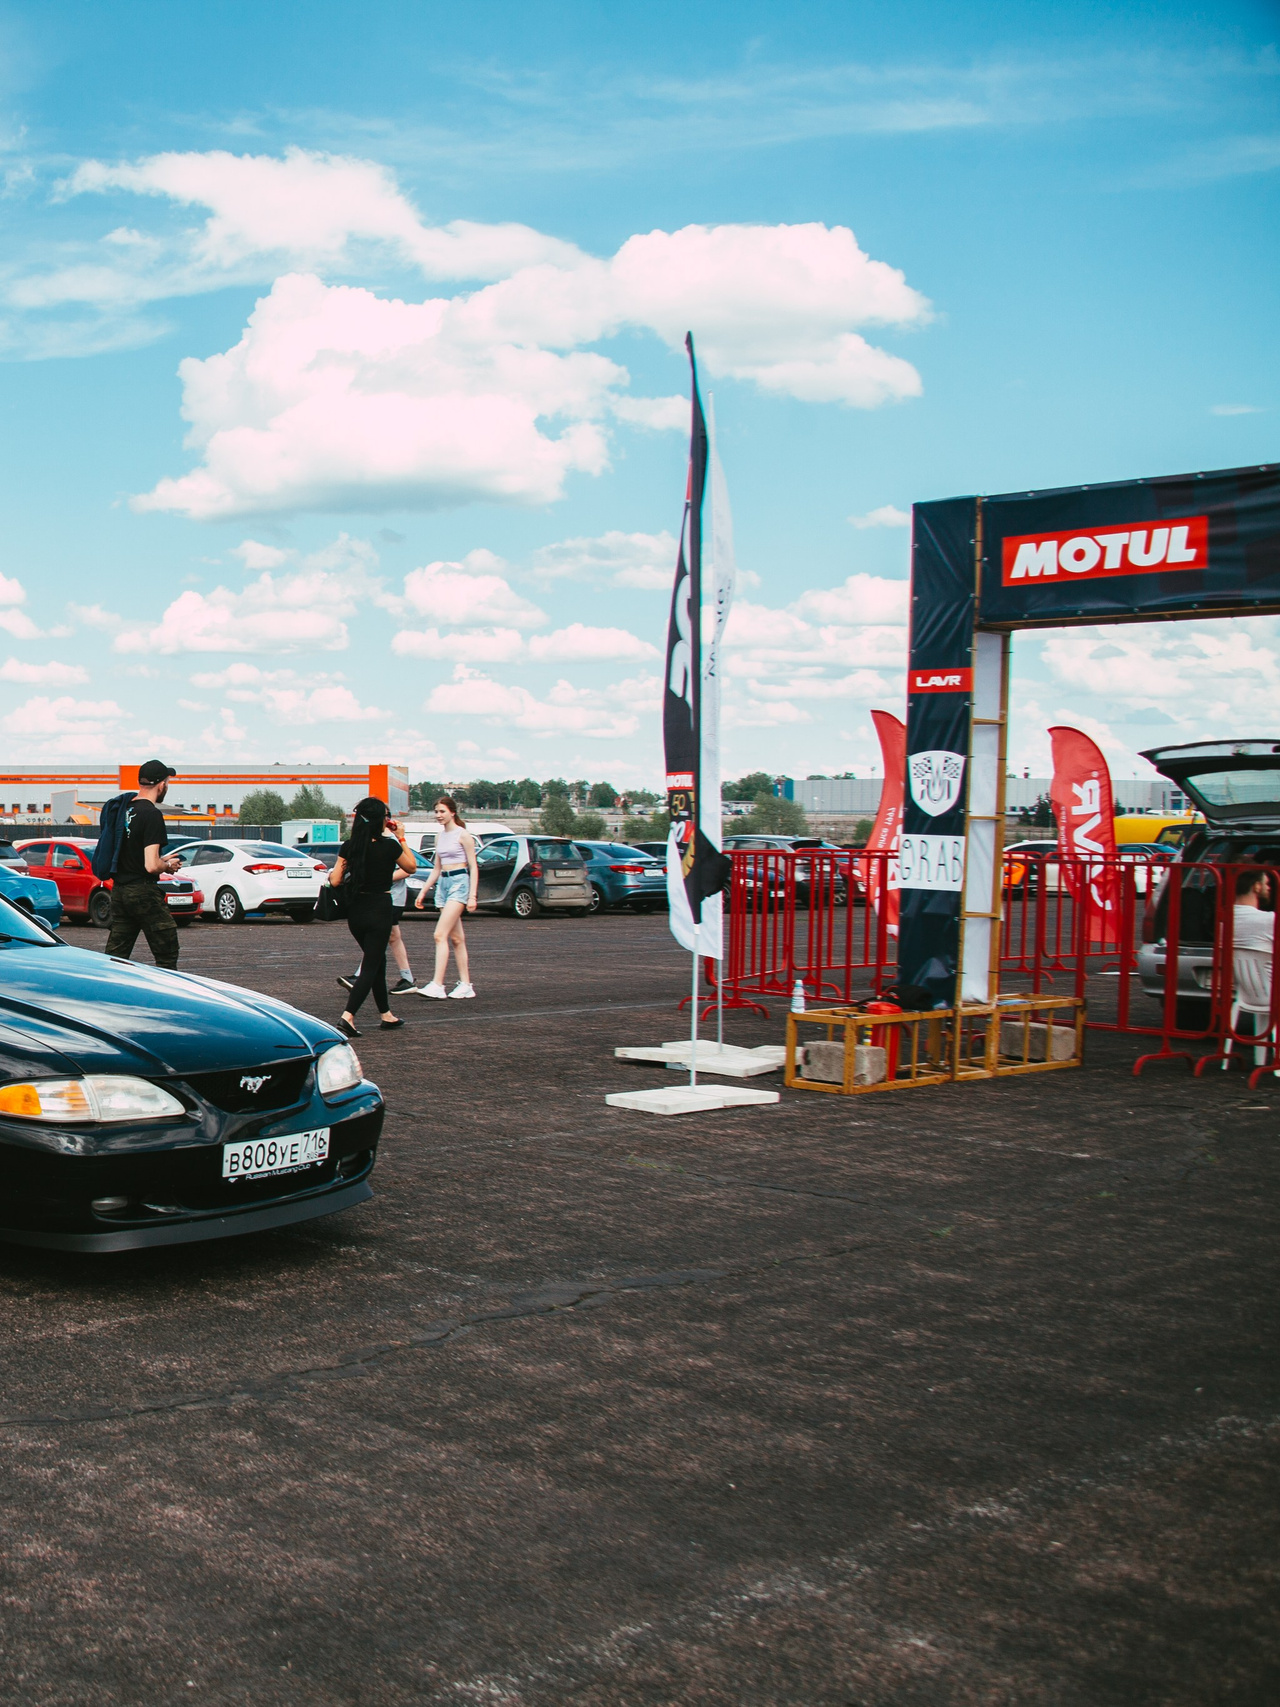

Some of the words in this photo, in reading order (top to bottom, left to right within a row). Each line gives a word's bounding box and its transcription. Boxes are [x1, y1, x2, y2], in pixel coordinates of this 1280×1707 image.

[1010, 525, 1197, 579] MOTUL
[915, 675, 962, 688] LAVR
[671, 794, 686, 816] 50
[303, 1130, 326, 1153] 716
[306, 1151, 318, 1160] RUS
